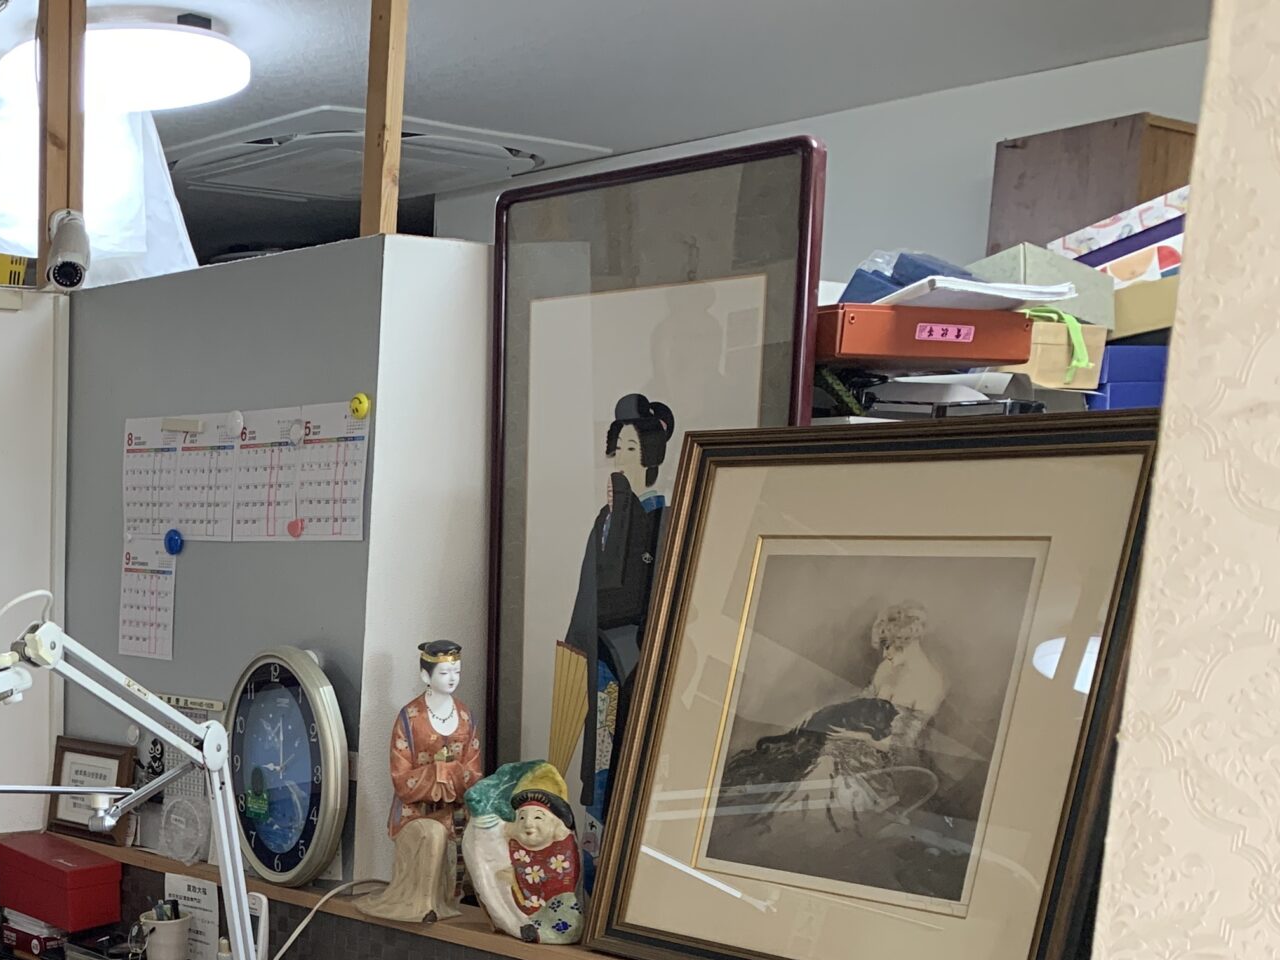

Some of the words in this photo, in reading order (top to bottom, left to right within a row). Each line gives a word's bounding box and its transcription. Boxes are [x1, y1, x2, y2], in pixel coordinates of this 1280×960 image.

[183, 431, 189, 443] 7
[241, 427, 247, 441] 6
[304, 421, 311, 436] 5
[127, 433, 133, 446] 8
[125, 552, 131, 565] 9
[271, 664, 280, 682] 12
[247, 682, 255, 699] 11
[298, 687, 303, 703] 1
[236, 717, 245, 733] 10
[310, 723, 317, 742] 2
[234, 755, 241, 772] 9
[313, 766, 322, 784] 3
[238, 794, 245, 812] 8
[310, 807, 318, 825] 4
[250, 831, 257, 848] 7
[298, 840, 306, 858] 5
[274, 855, 282, 872] 6
